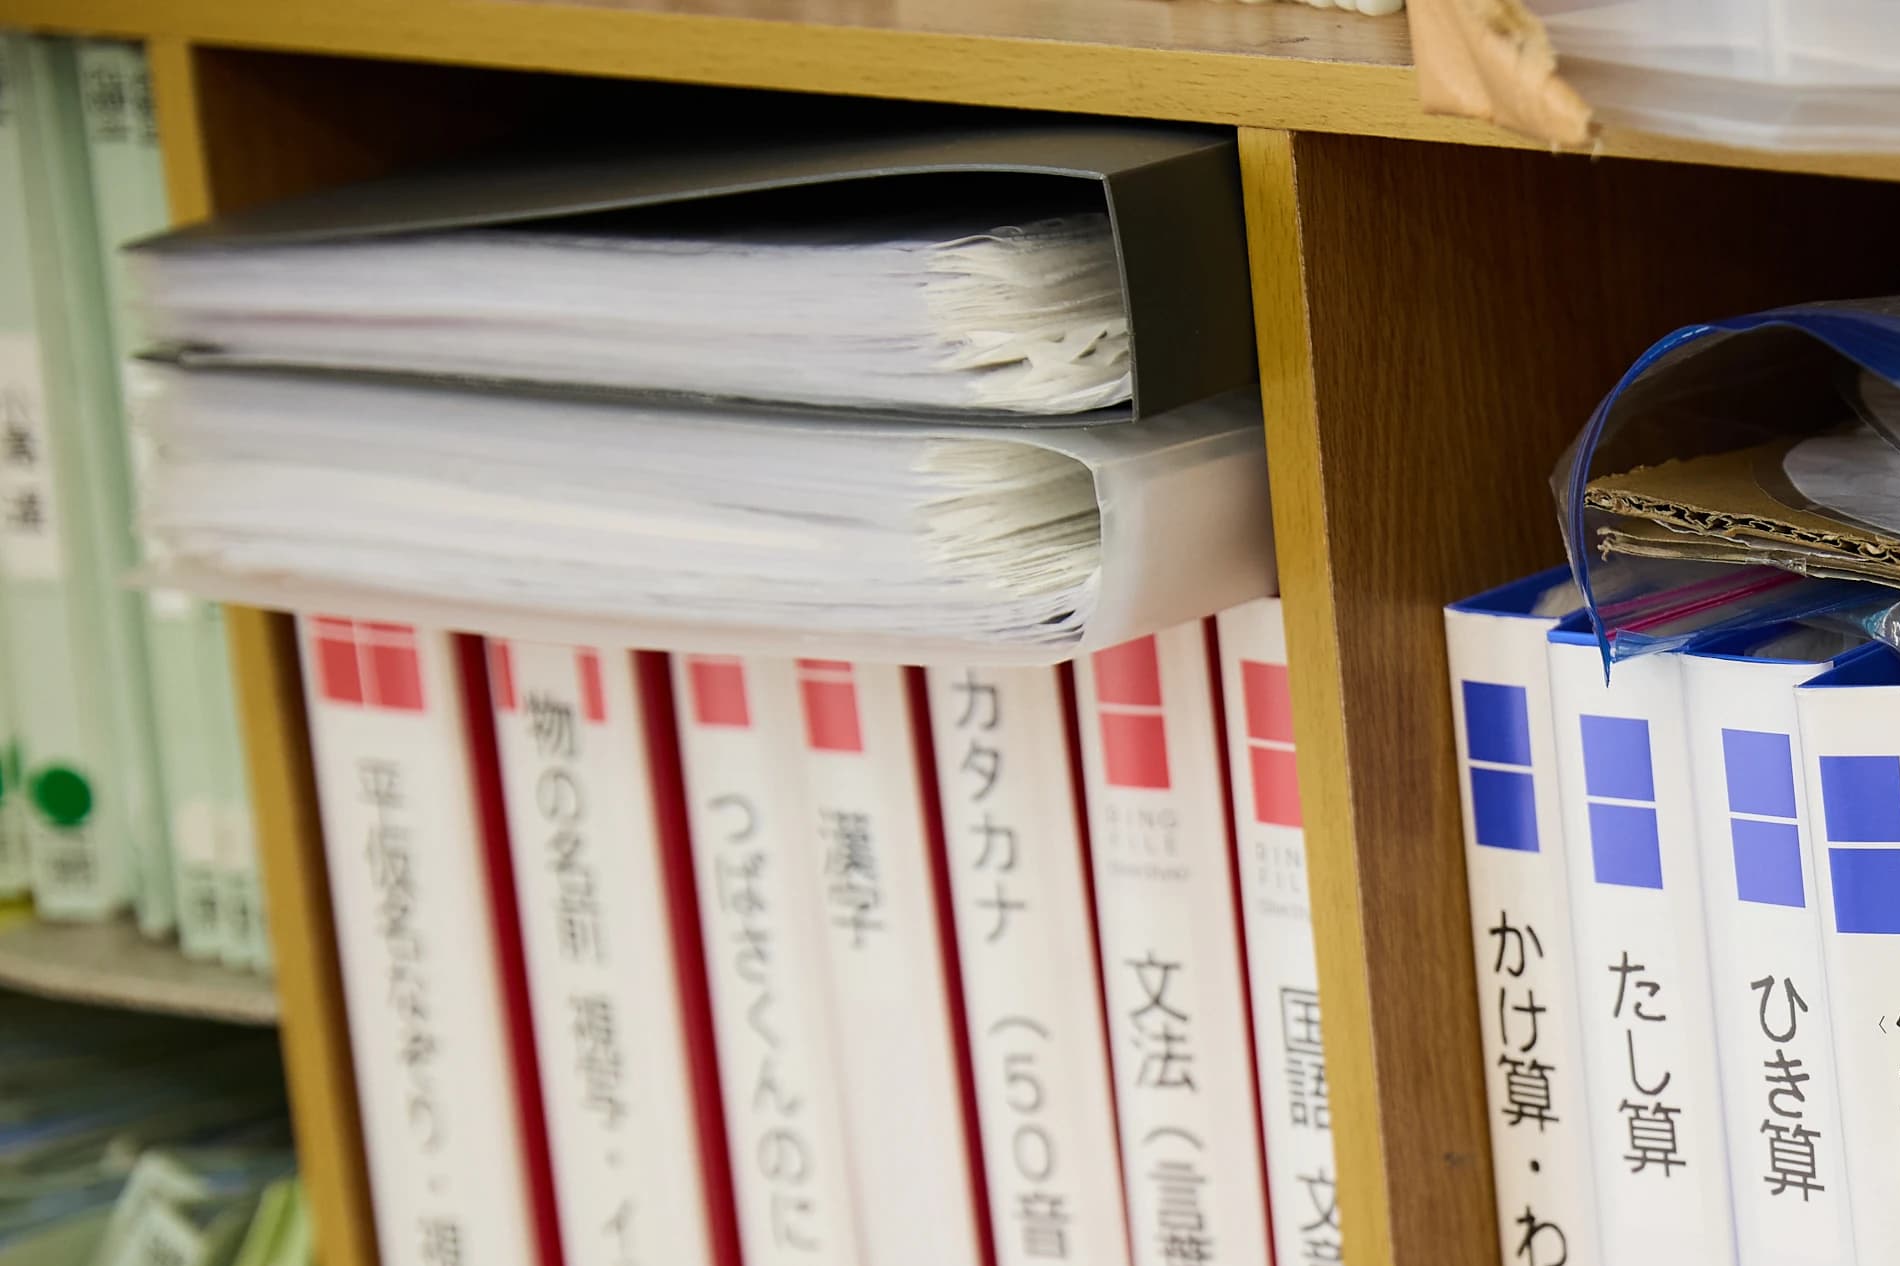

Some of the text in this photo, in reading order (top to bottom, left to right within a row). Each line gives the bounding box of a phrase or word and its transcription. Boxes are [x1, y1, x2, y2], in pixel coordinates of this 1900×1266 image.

[521, 690, 607, 963] 物の名前
[818, 804, 887, 952] 漢字
[951, 667, 1028, 945] カタカナ
[1254, 841, 1304, 869] RIN
[1607, 950, 1688, 1178] たし算
[1750, 974, 1826, 1202] ひき算
